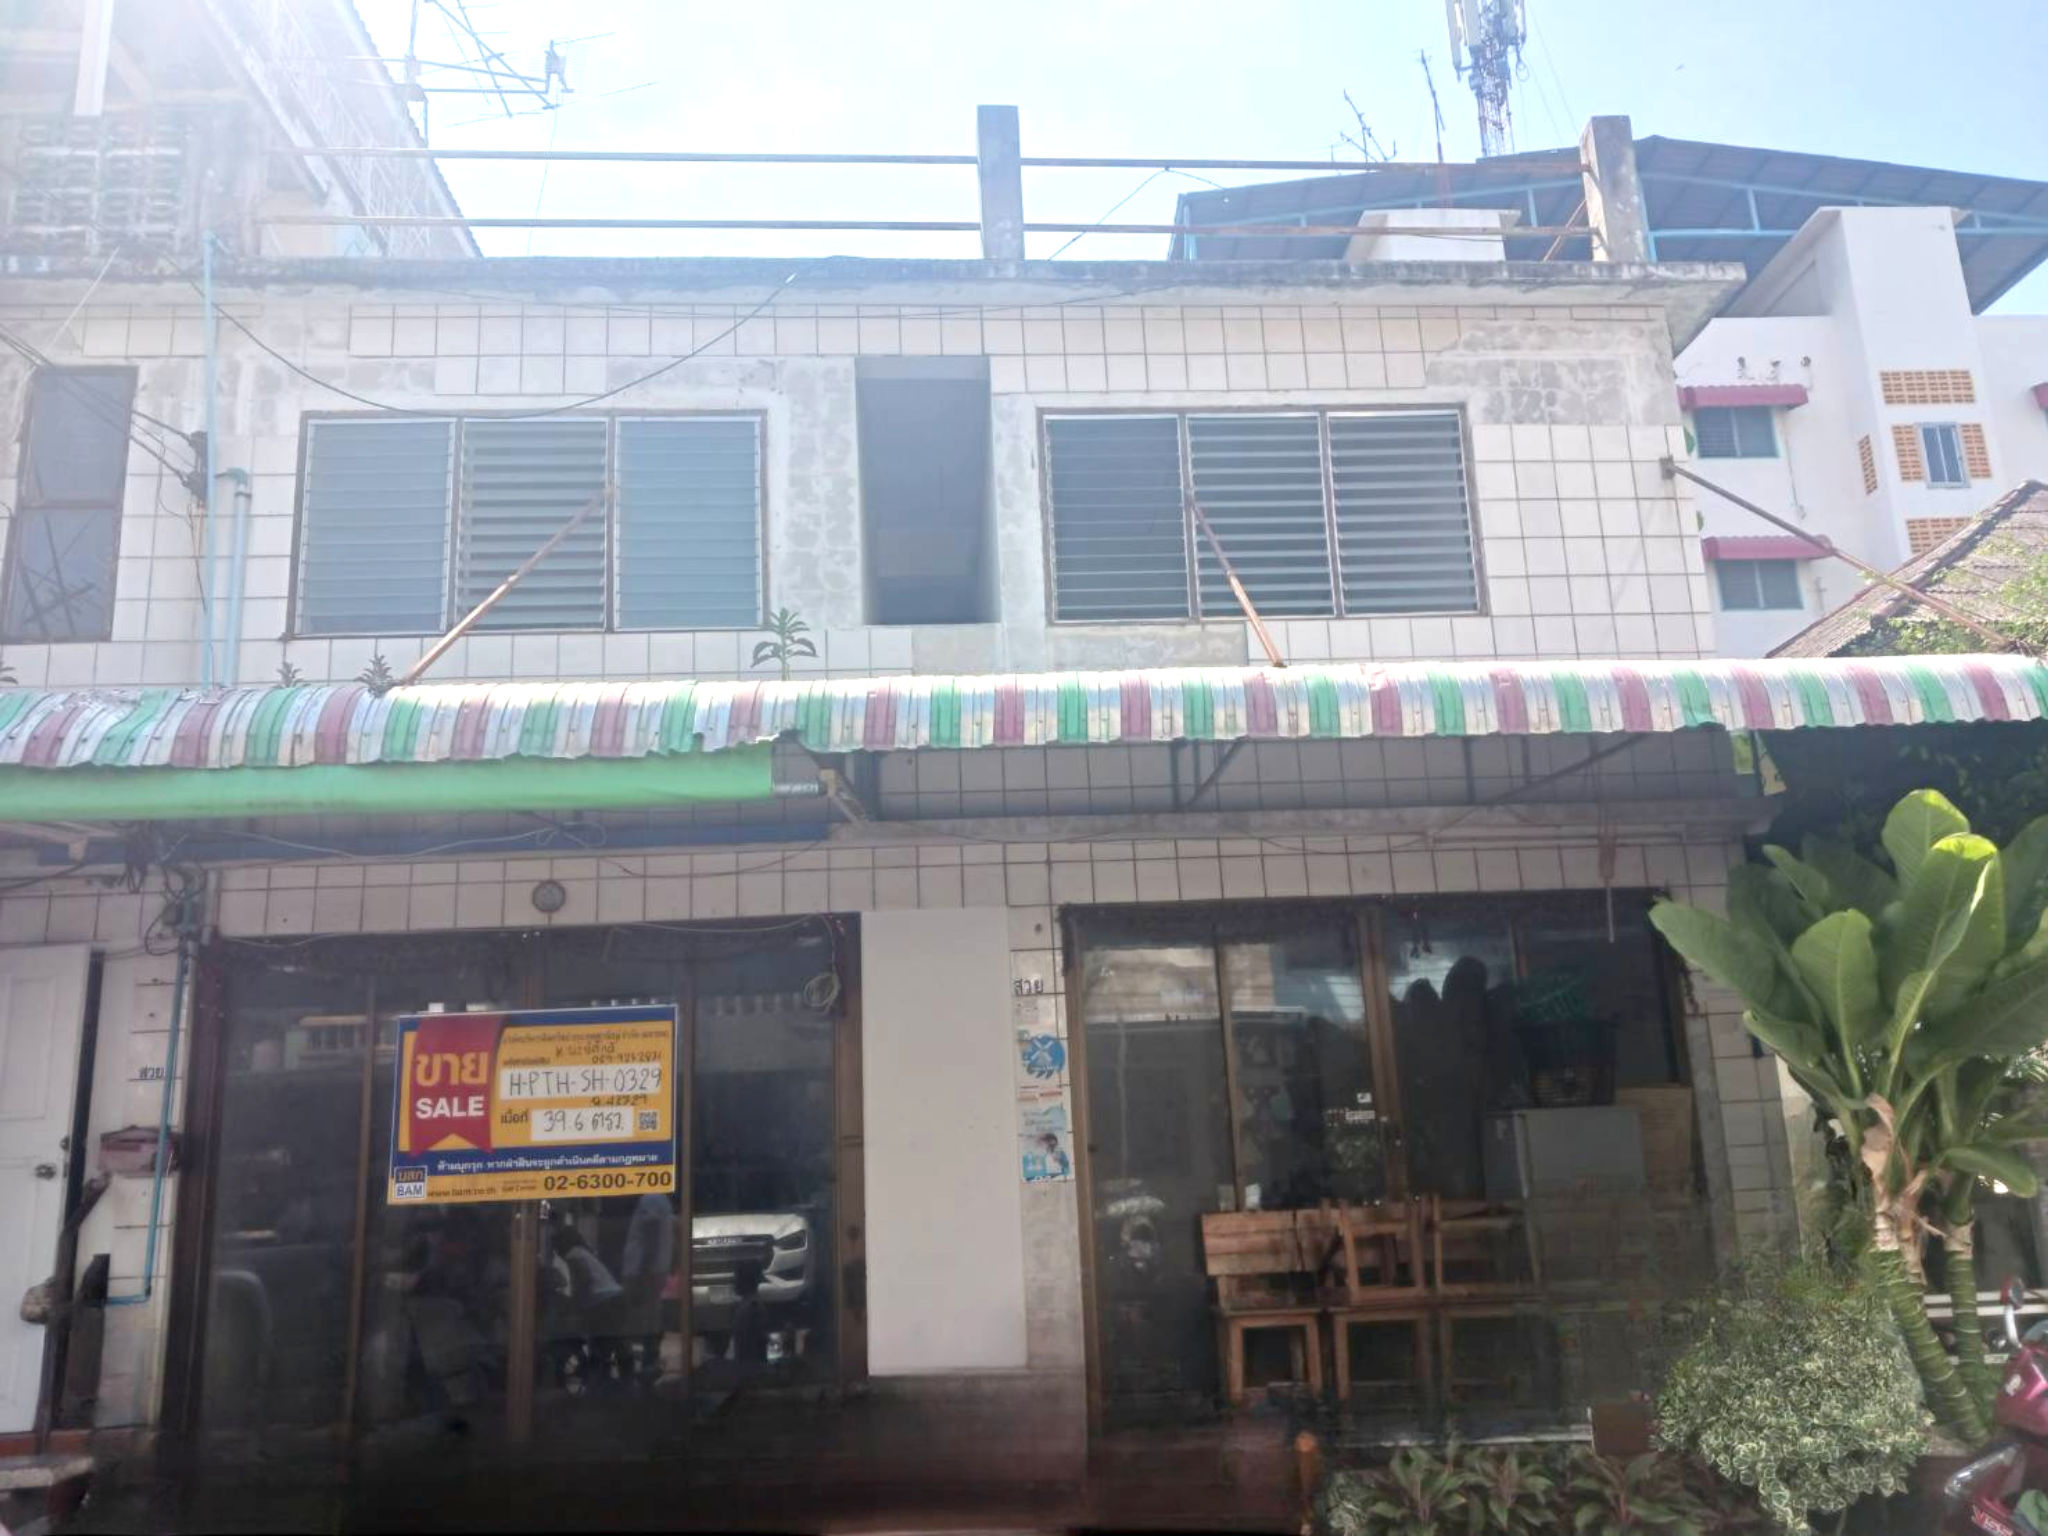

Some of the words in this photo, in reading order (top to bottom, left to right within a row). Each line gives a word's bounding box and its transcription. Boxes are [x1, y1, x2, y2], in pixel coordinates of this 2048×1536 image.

[416, 1052, 488, 1086] ขาย
[415, 1096, 485, 1119] SALE
[396, 1183, 424, 1197] BAM
[544, 1171, 672, 1191] 02-6300-700
